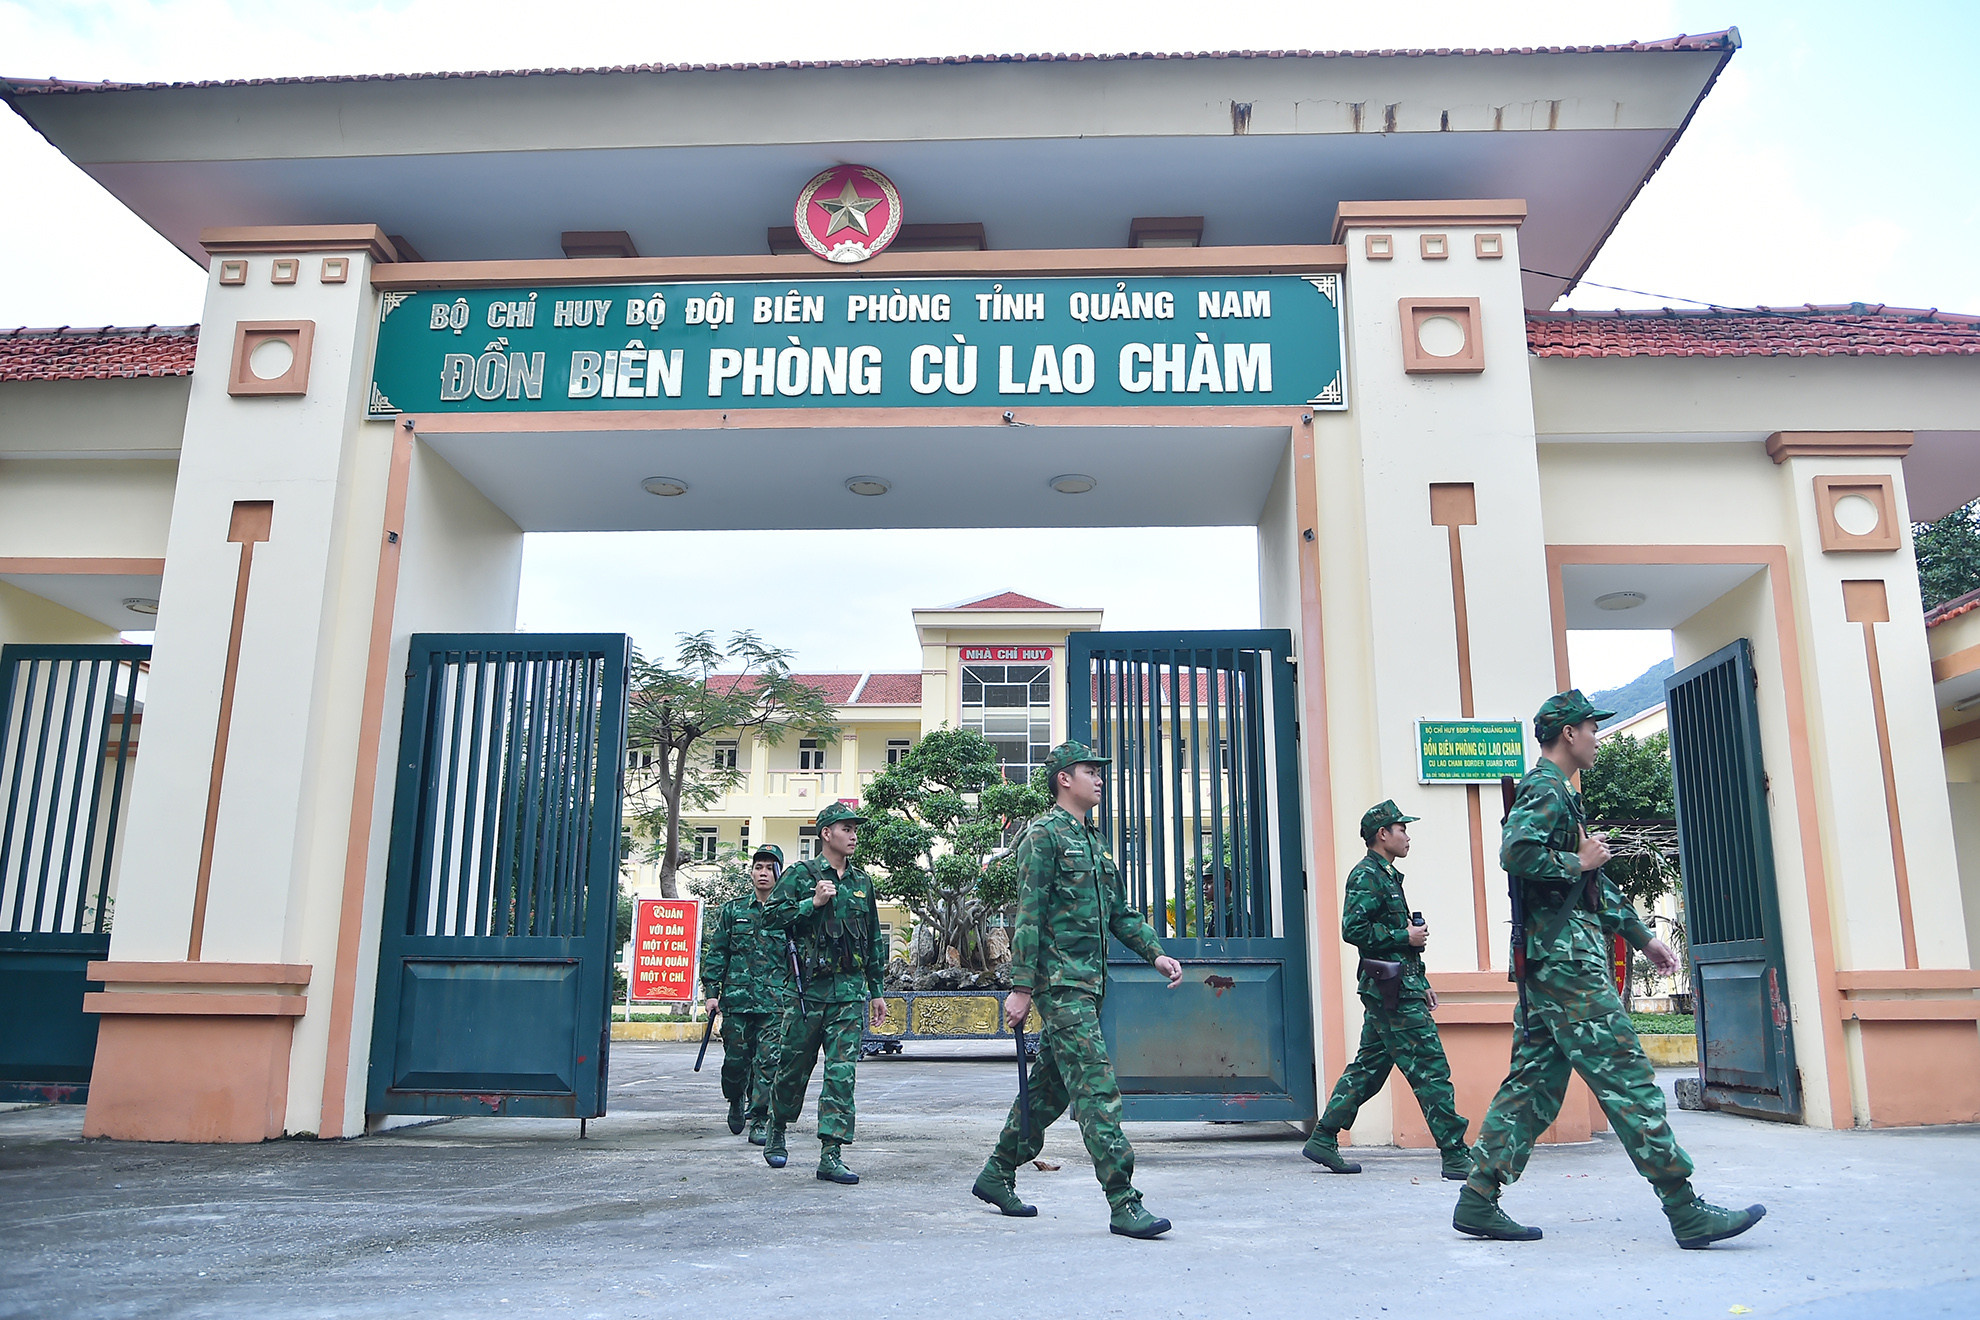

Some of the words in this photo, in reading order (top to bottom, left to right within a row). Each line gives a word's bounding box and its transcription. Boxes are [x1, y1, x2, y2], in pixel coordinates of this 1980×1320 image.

[429, 298, 470, 335] BỘ
[487, 291, 539, 328] CHỈ
[554, 300, 613, 328] HUY
[625, 293, 667, 331] BỘ
[685, 292, 735, 331] ĐỘI
[752, 289, 825, 324] BIÊN
[847, 288, 952, 323] PHÒNG
[975, 283, 1045, 321] TỈNH
[1069, 281, 1174, 323] QUẢNG
[1198, 290, 1272, 319] NAM
[439, 336, 546, 401] ĐỒN
[567, 339, 685, 399] BIÊN
[707, 335, 883, 398] PHÒNG
[909, 332, 979, 395] CÙ
[999, 342, 1096, 395] LAO
[1118, 332, 1273, 394] CHÀM
[965, 647, 993, 660] NHÀ
[996, 647, 1018, 660] CHỈ
[1022, 649, 1047, 660] HUY
[1503, 726, 1517, 734] NAM
[1438, 738, 1455, 756] BIÊN
[1455, 738, 1477, 756] PHÒNG
[1477, 738, 1487, 756] CÙ
[1488, 742, 1501, 756] LAO
[1502, 738, 1522, 756] CHÀM
[1437, 759, 1447, 767] LAO
[1464, 759, 1485, 767] BORDER
[1485, 759, 1503, 767] GUARD
[1504, 759, 1518, 767] POST
[653, 905, 683, 919] QUÂN
[649, 924, 664, 935] VỚI
[665, 924, 684, 936] DÂN
[642, 939, 661, 952] MỘT
[663, 939, 669, 951] Ý
[671, 939, 688, 952] CHÍ,
[640, 955, 663, 966] TOÀN
[664, 955, 689, 967] QUÂN
[640, 970, 659, 983] MỘT
[661, 970, 668, 982] Ý
[669, 970, 686, 982] CHÍ.
